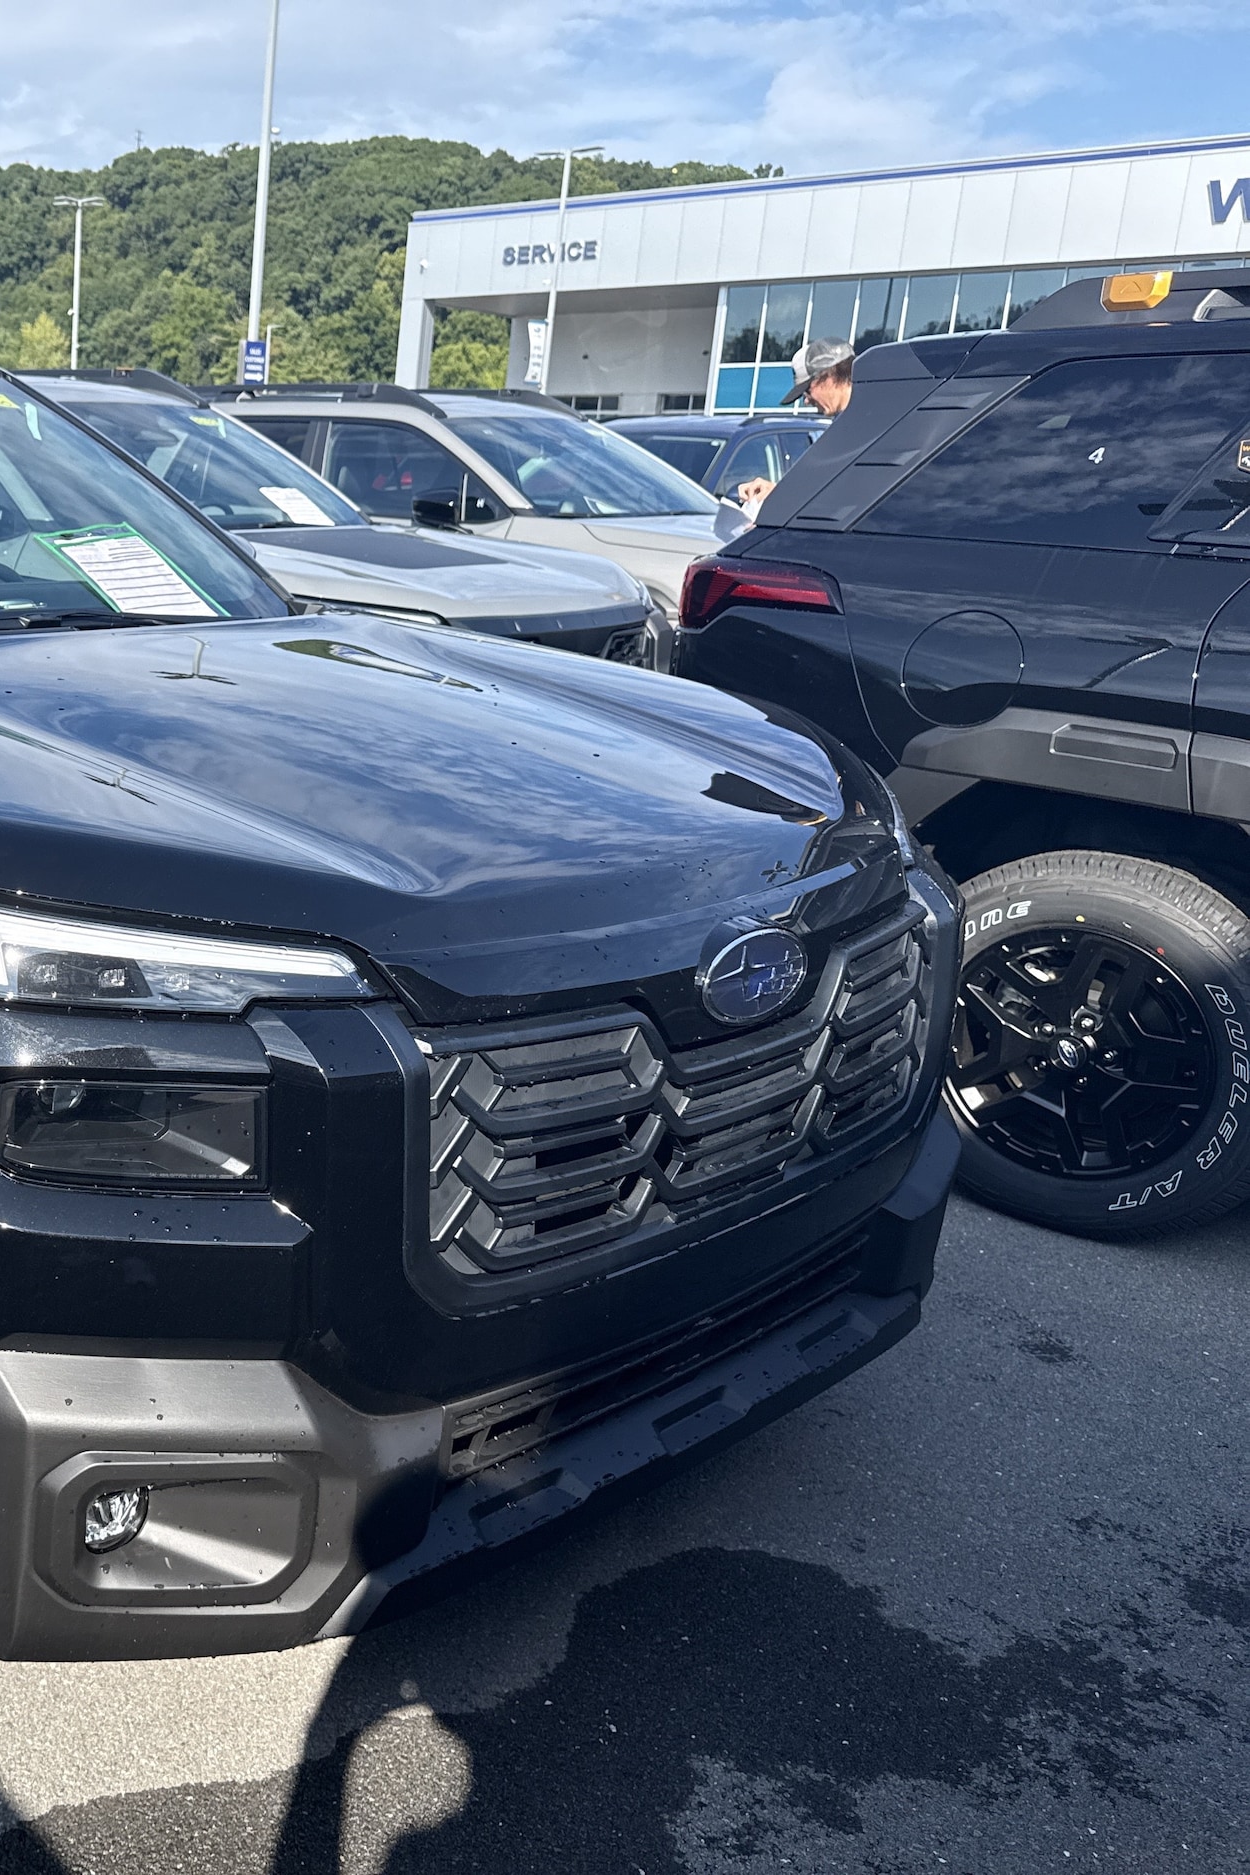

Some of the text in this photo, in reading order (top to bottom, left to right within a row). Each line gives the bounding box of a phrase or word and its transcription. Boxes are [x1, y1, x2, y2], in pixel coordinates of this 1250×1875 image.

[502, 240, 597, 266] SERVICE
[1088, 447, 1105, 464] 4
[1108, 983, 1249, 1211] DUELER A/T
